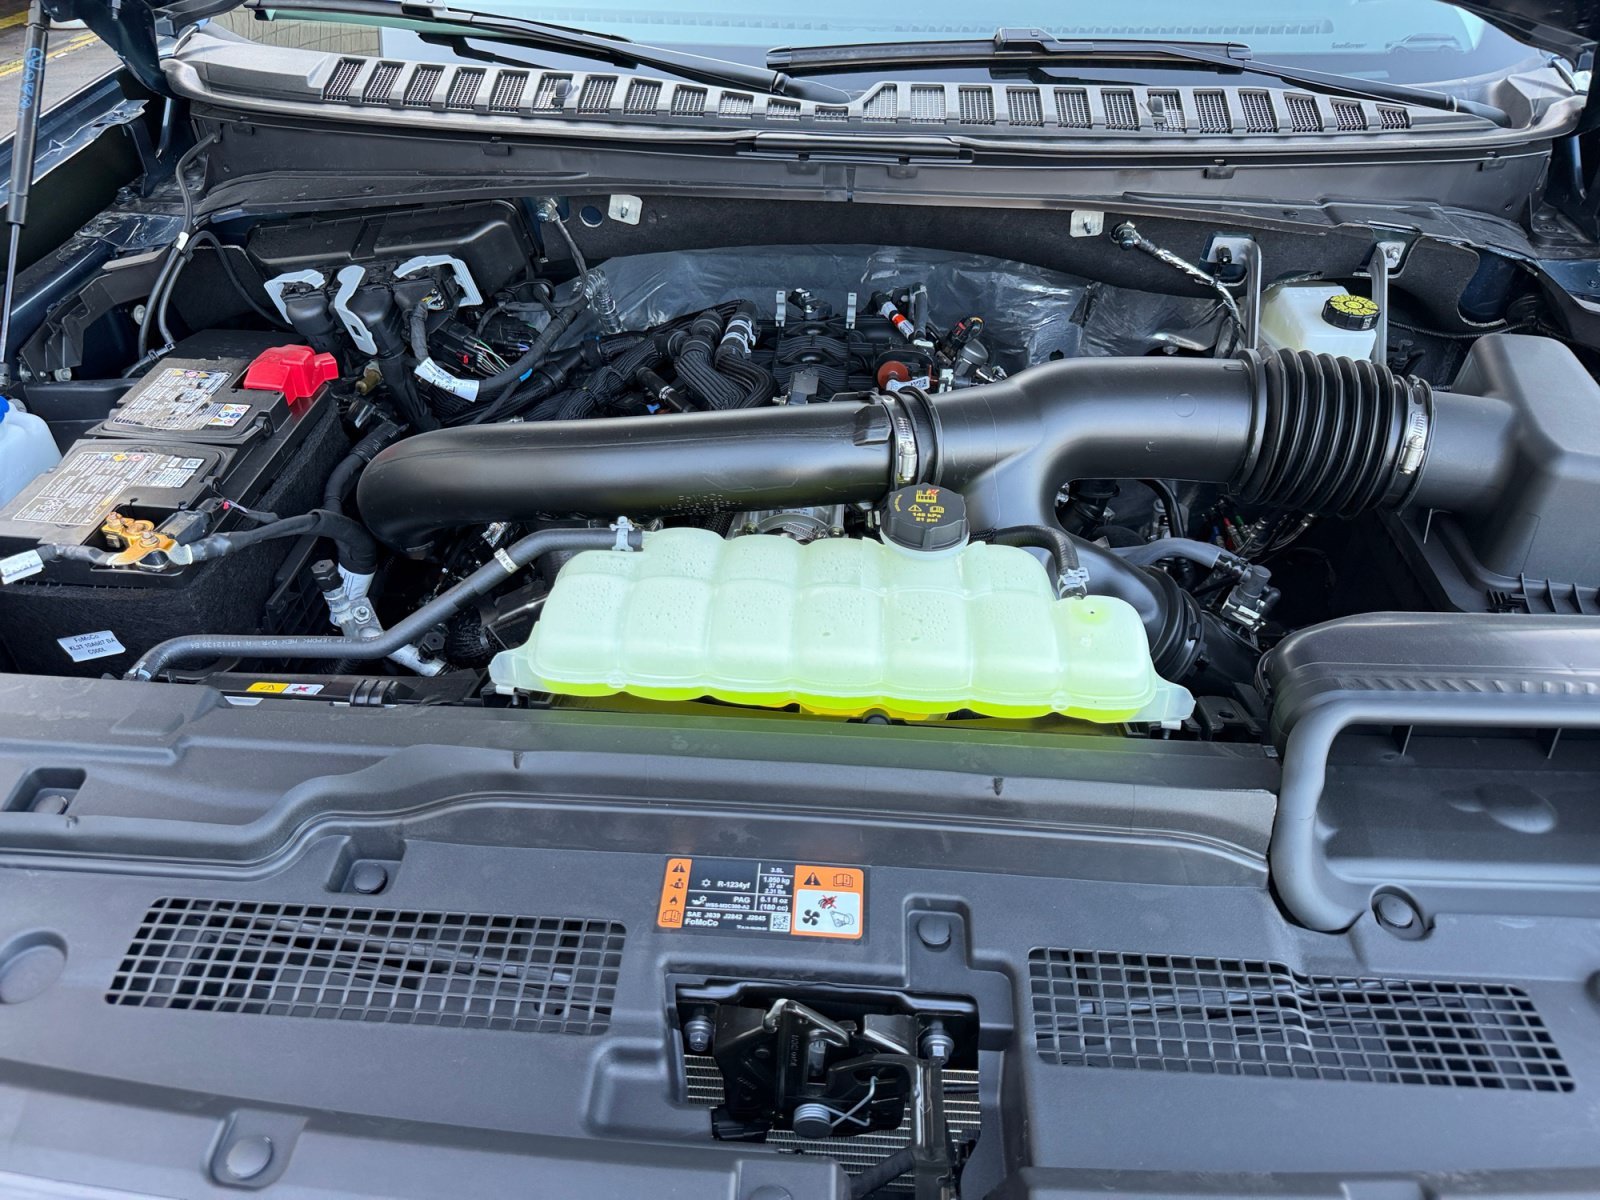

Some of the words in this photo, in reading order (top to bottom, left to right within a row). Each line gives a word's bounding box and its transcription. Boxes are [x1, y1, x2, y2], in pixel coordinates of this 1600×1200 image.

[716, 880, 751, 890] R-1234yf
[782, 877, 790, 885] kg
[685, 918, 719, 926] FoMoCo
